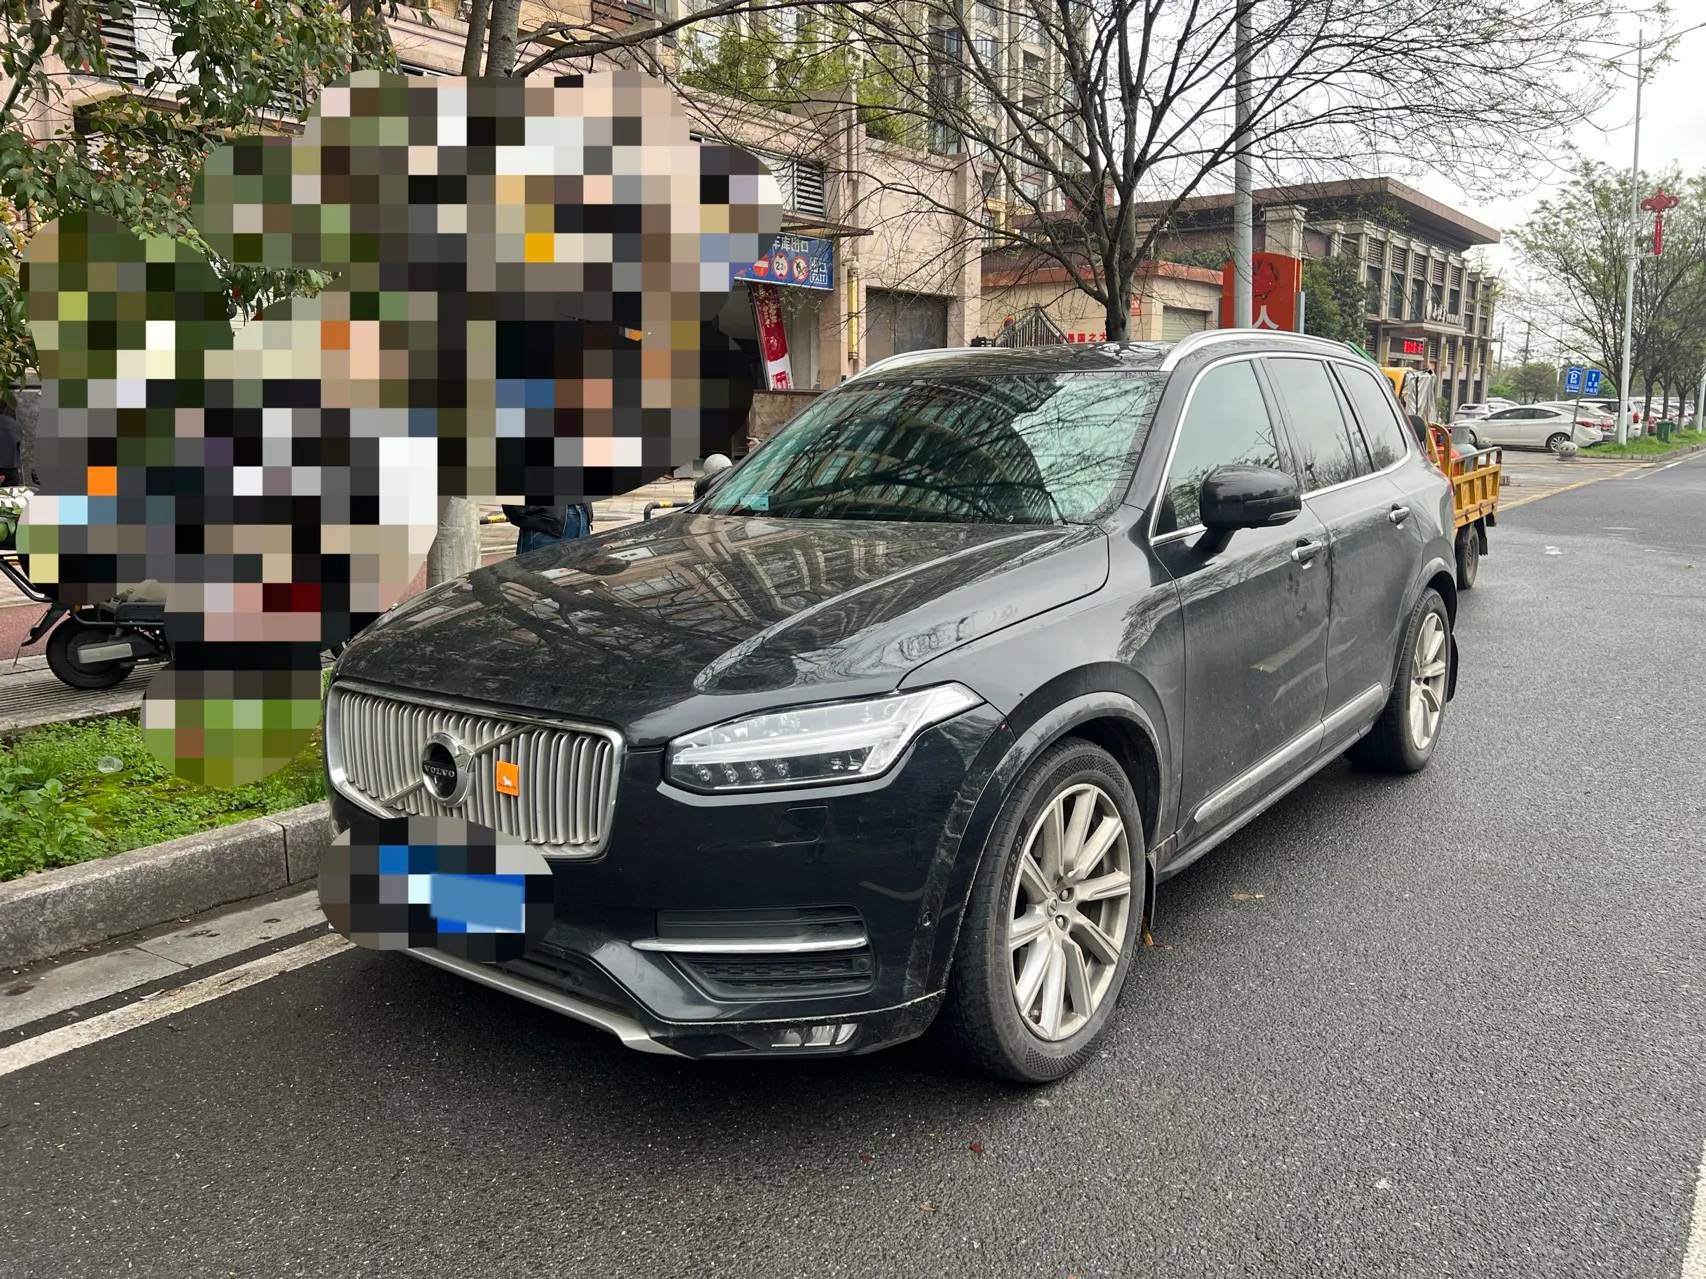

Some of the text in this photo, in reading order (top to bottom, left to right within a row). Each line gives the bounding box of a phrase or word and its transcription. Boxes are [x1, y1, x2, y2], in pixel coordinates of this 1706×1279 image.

[812, 273, 827, 283] EXIT
[1252, 305, 1280, 330] 人
[1570, 373, 1578, 384] P
[423, 764, 455, 778] VOLVO
[1015, 835, 1023, 852] 20
